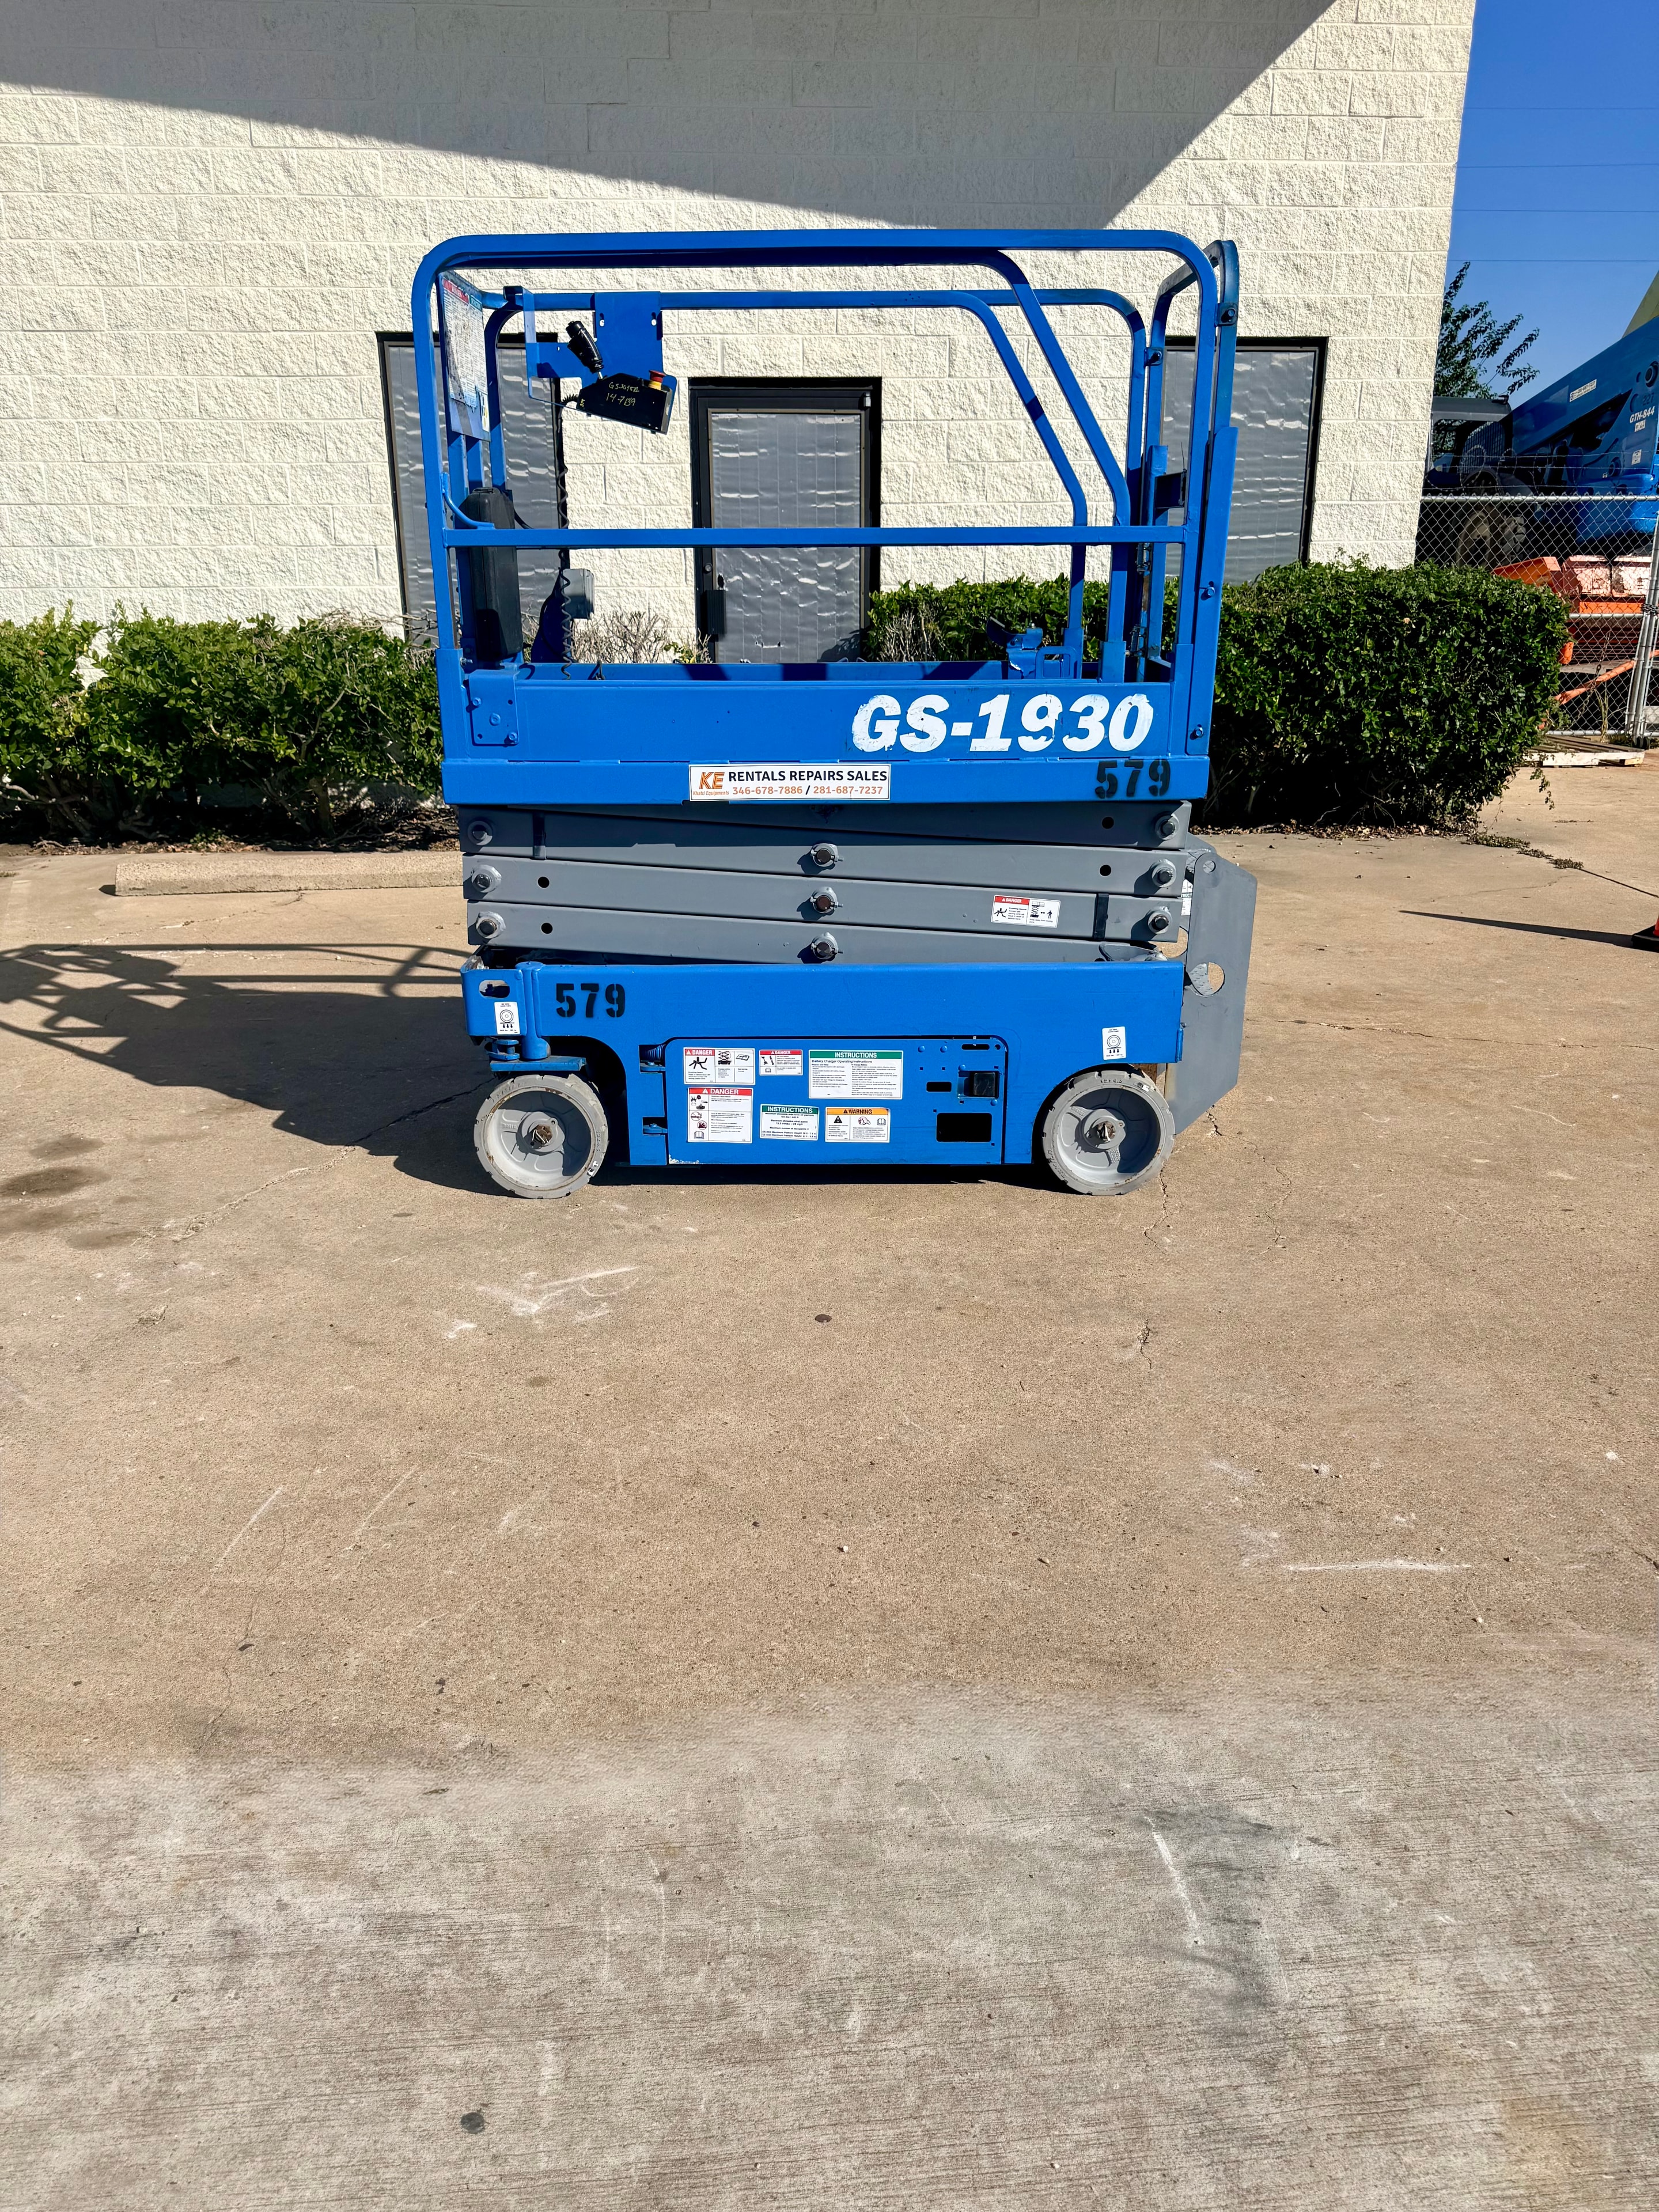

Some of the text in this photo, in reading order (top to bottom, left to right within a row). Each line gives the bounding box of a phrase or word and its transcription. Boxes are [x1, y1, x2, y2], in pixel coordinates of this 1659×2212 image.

[1630, 406, 1655, 423] GTH-844
[853, 694, 1154, 752] GS-1930
[699, 772, 725, 789] KE
[729, 770, 887, 782] RENTALS REPAIRS SALES
[1095, 759, 1171, 799] 579
[732, 786, 802, 795] 346-678-7886
[813, 786, 883, 795] 281-687-7237
[556, 983, 626, 1018] 579
